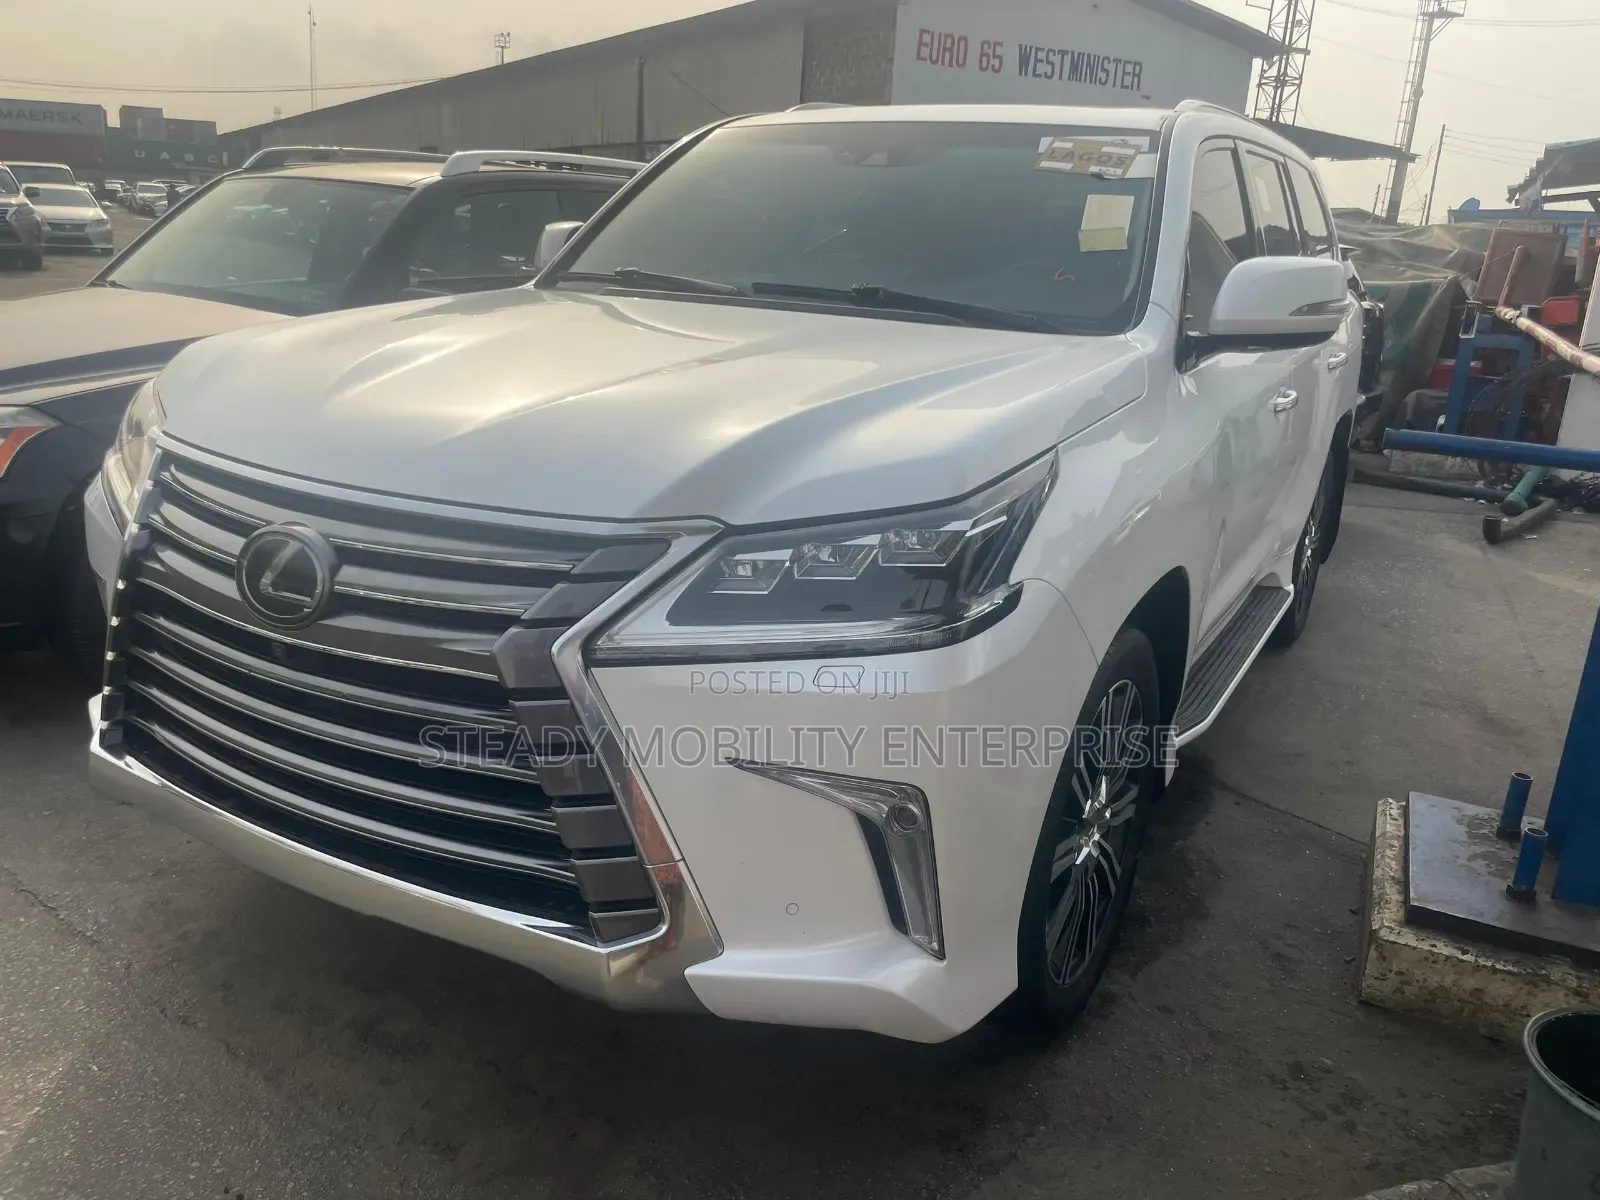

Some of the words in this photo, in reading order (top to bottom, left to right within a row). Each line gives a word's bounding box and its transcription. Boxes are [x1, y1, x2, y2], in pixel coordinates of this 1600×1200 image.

[916, 28, 968, 69] EURO
[978, 39, 1004, 75] 65
[1017, 43, 1144, 92] WESTMINISTER
[0, 107, 83, 125] MAERSK
